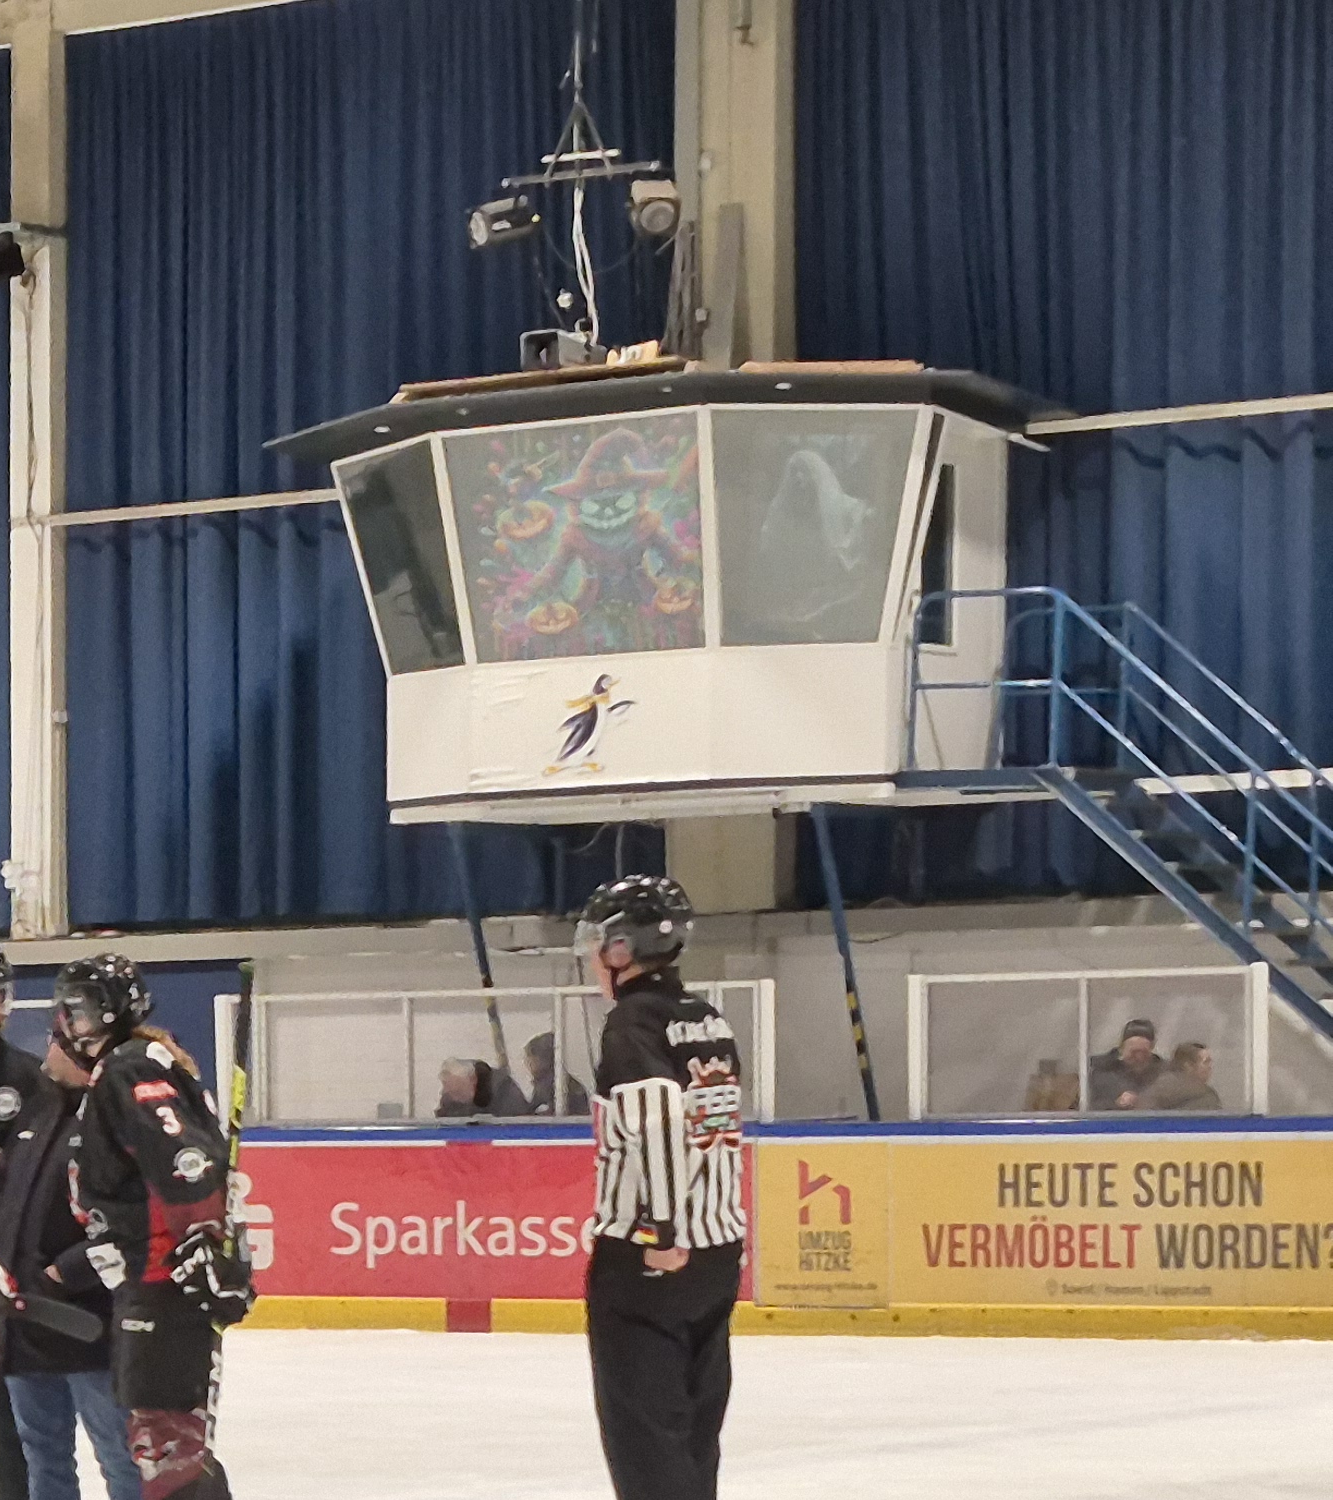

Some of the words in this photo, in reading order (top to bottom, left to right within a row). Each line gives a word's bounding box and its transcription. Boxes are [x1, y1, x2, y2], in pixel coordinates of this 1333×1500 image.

[997, 1162, 1119, 1207] HEUTE
[1132, 1161, 1264, 1207] SCHON
[798, 1230, 852, 1250] UMZUG
[922, 1215, 1142, 1269] VERMÖBELT
[1155, 1222, 1333, 1270] WORDEN?
[798, 1252, 852, 1272] HITZKE
